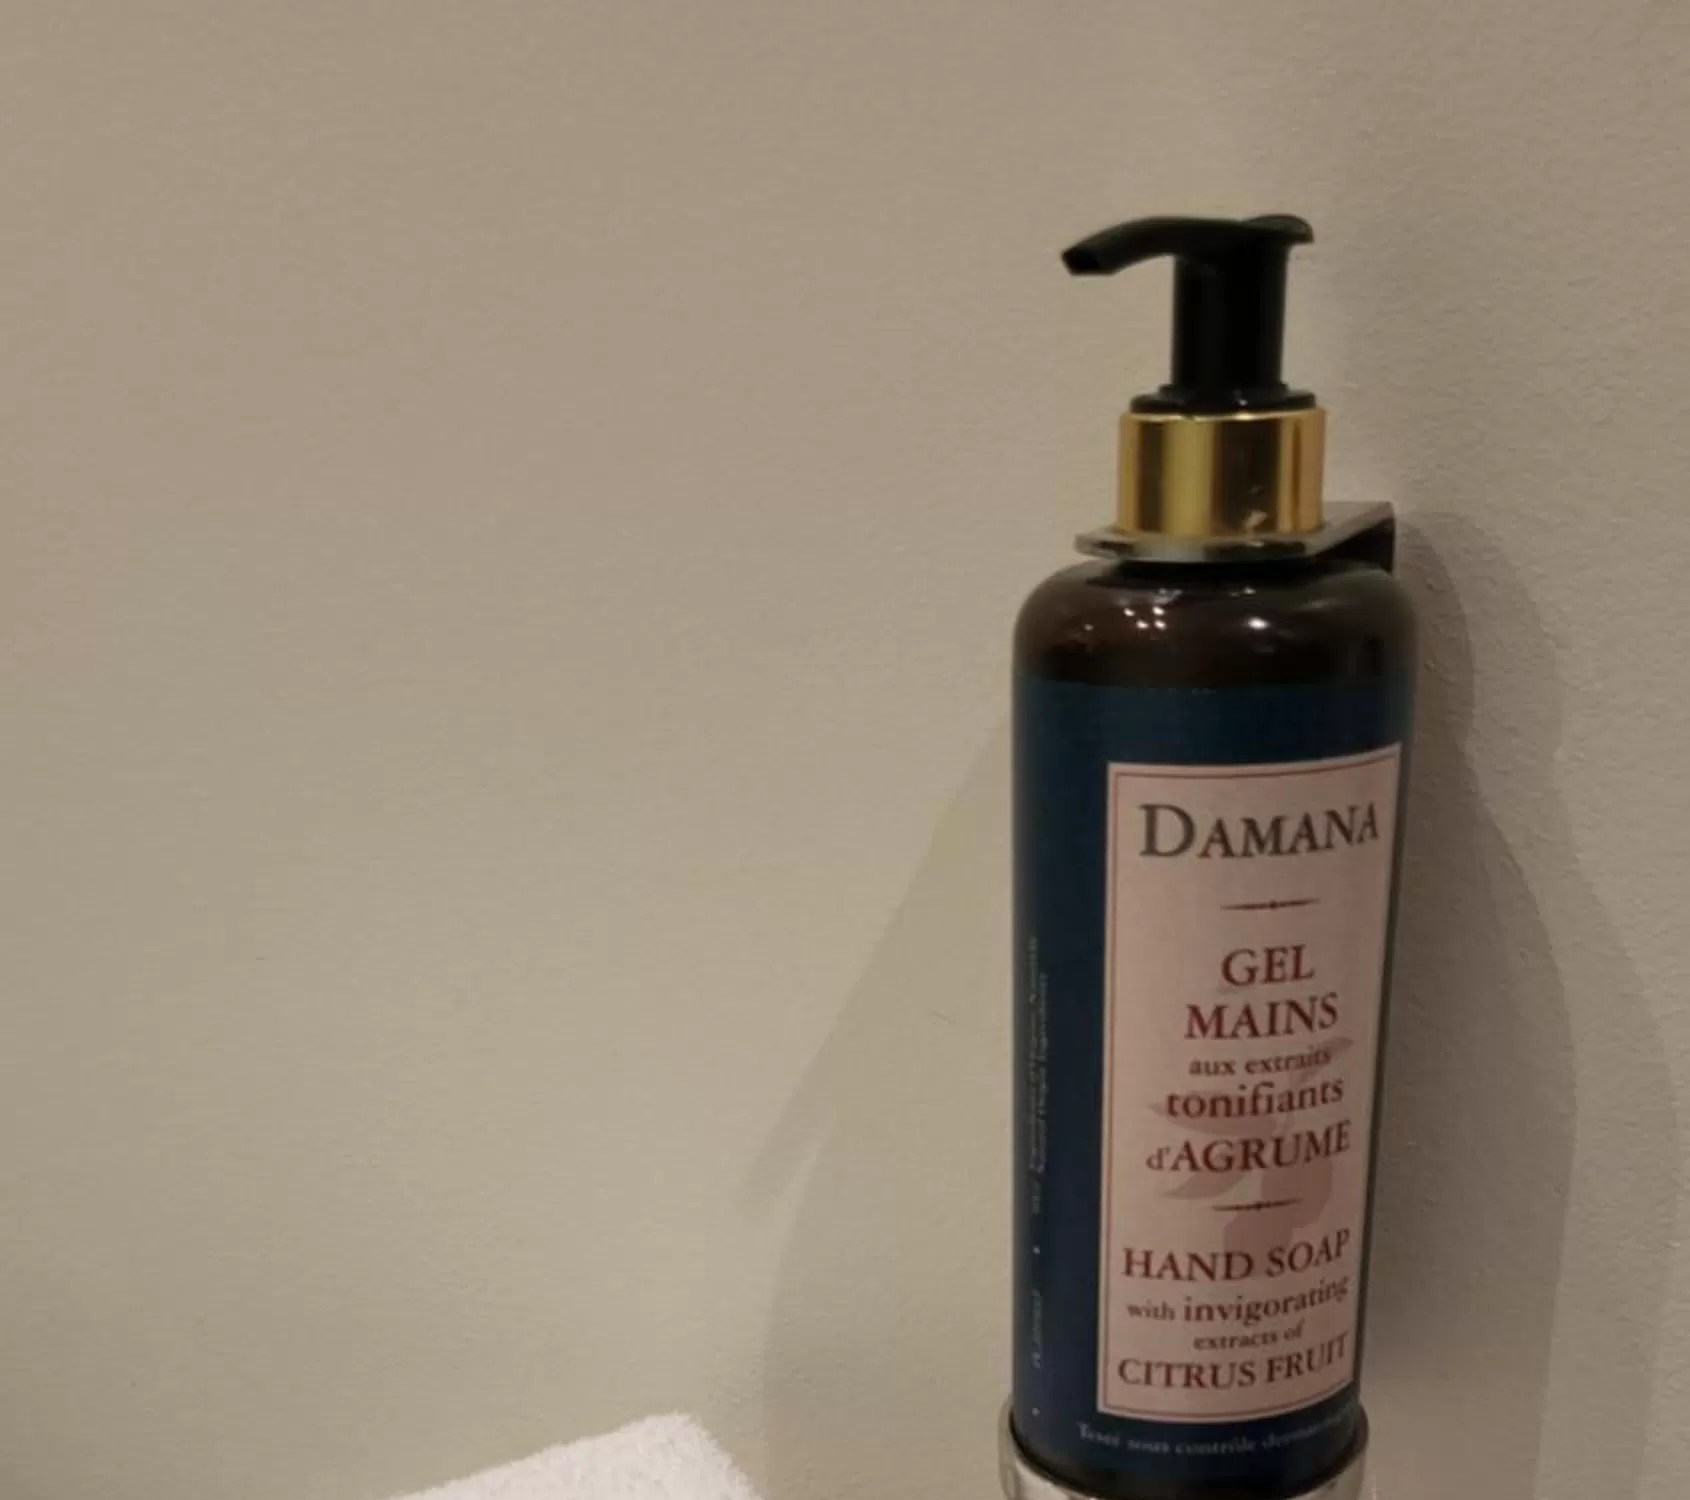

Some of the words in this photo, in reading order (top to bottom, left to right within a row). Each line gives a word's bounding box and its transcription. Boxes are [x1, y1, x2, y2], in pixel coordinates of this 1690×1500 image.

[1138, 803, 1380, 858] DAMANA
[1221, 944, 1315, 987] GEL
[1184, 992, 1339, 1040] MAINS
[1189, 1055, 1236, 1076] aux
[1244, 1045, 1333, 1075] extraits
[1165, 1078, 1345, 1119] tonifiants
[1146, 1120, 1352, 1173] d'AGRUME
[1123, 1248, 1255, 1282] HAND
[1264, 1228, 1351, 1278] SOAP
[1127, 1299, 1177, 1321] with
[1183, 1276, 1350, 1327] invigorating
[1192, 1330, 1278, 1352] extracts
[1283, 1318, 1305, 1343] of
[1118, 1357, 1257, 1390] CITRUS
[1264, 1332, 1349, 1384] FRUIT
